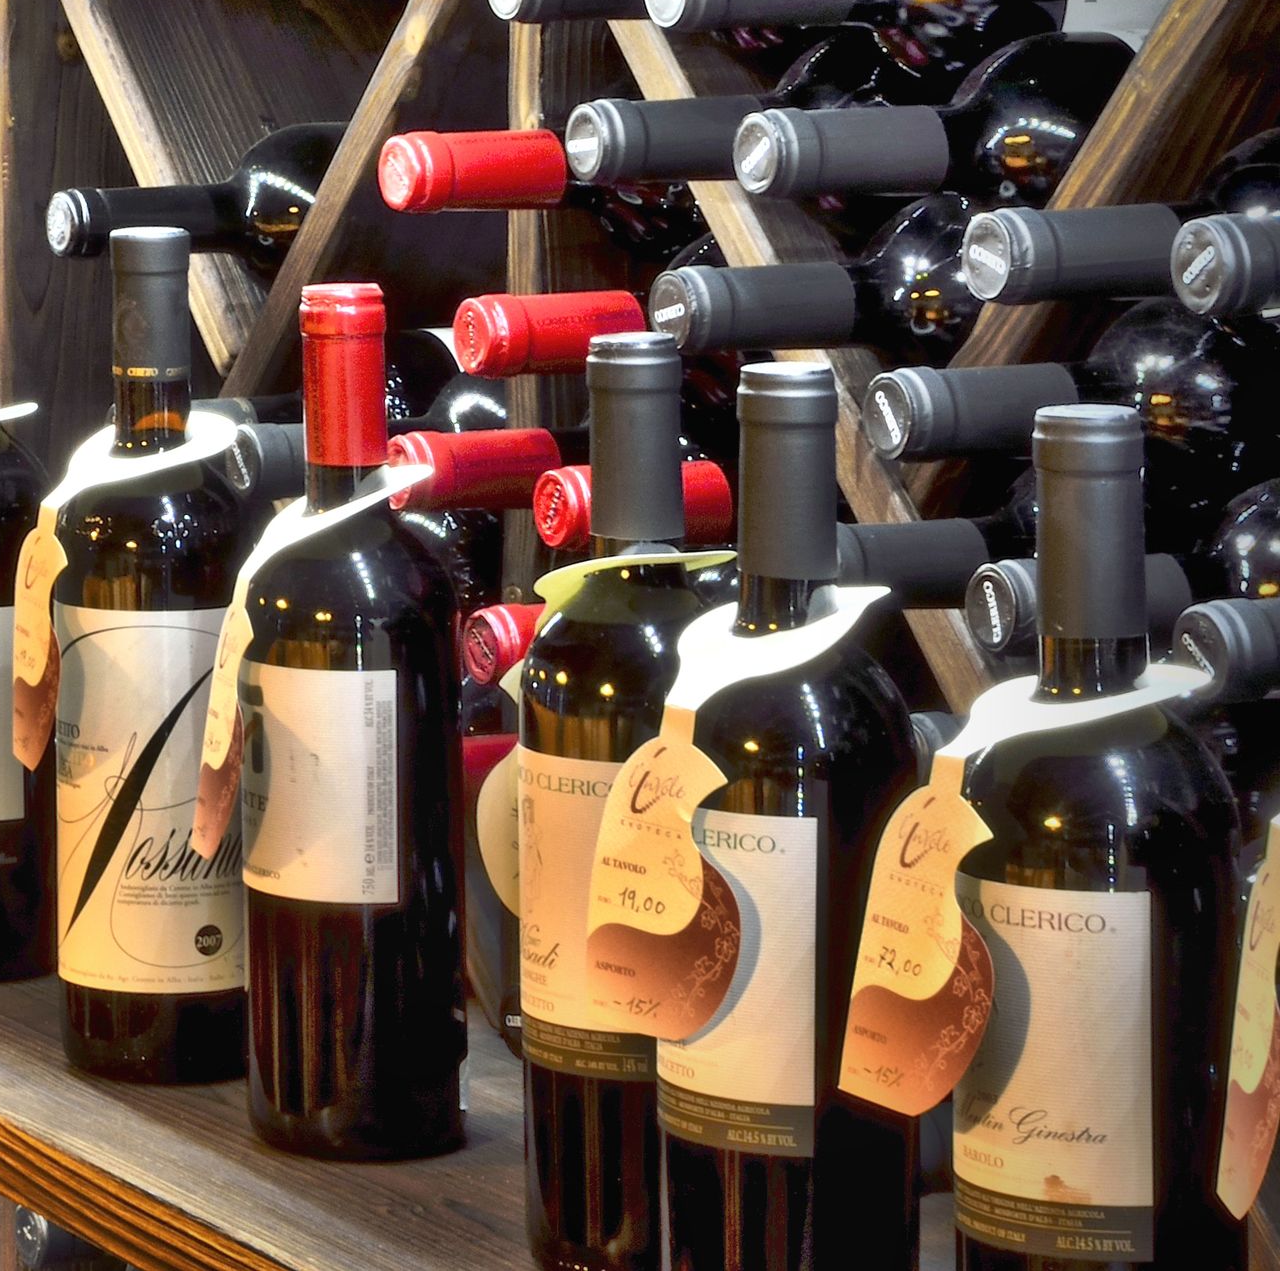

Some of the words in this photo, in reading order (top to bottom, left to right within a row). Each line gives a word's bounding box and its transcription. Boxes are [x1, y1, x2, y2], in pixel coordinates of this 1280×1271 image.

[620, 818, 683, 841] ENOTECA
[601, 855, 611, 867] AL
[612, 857, 648, 876] TAVOLO
[362, 877, 375, 896] 750
[618, 886, 666, 916] 19,00
[872, 913, 882, 924] AL
[881, 916, 910, 934] TAVOLO
[990, 902, 1107, 935] CLERICO
[196, 934, 223, 949] 2007
[593, 959, 637, 979] ASPORTO
[878, 944, 922, 977] 72,00
[612, 994, 662, 1019] -15%
[863, 1064, 905, 1088] -15%
[1008, 1105, 1108, 1146] Ginestra
[962, 1142, 1005, 1169] BAROLO
